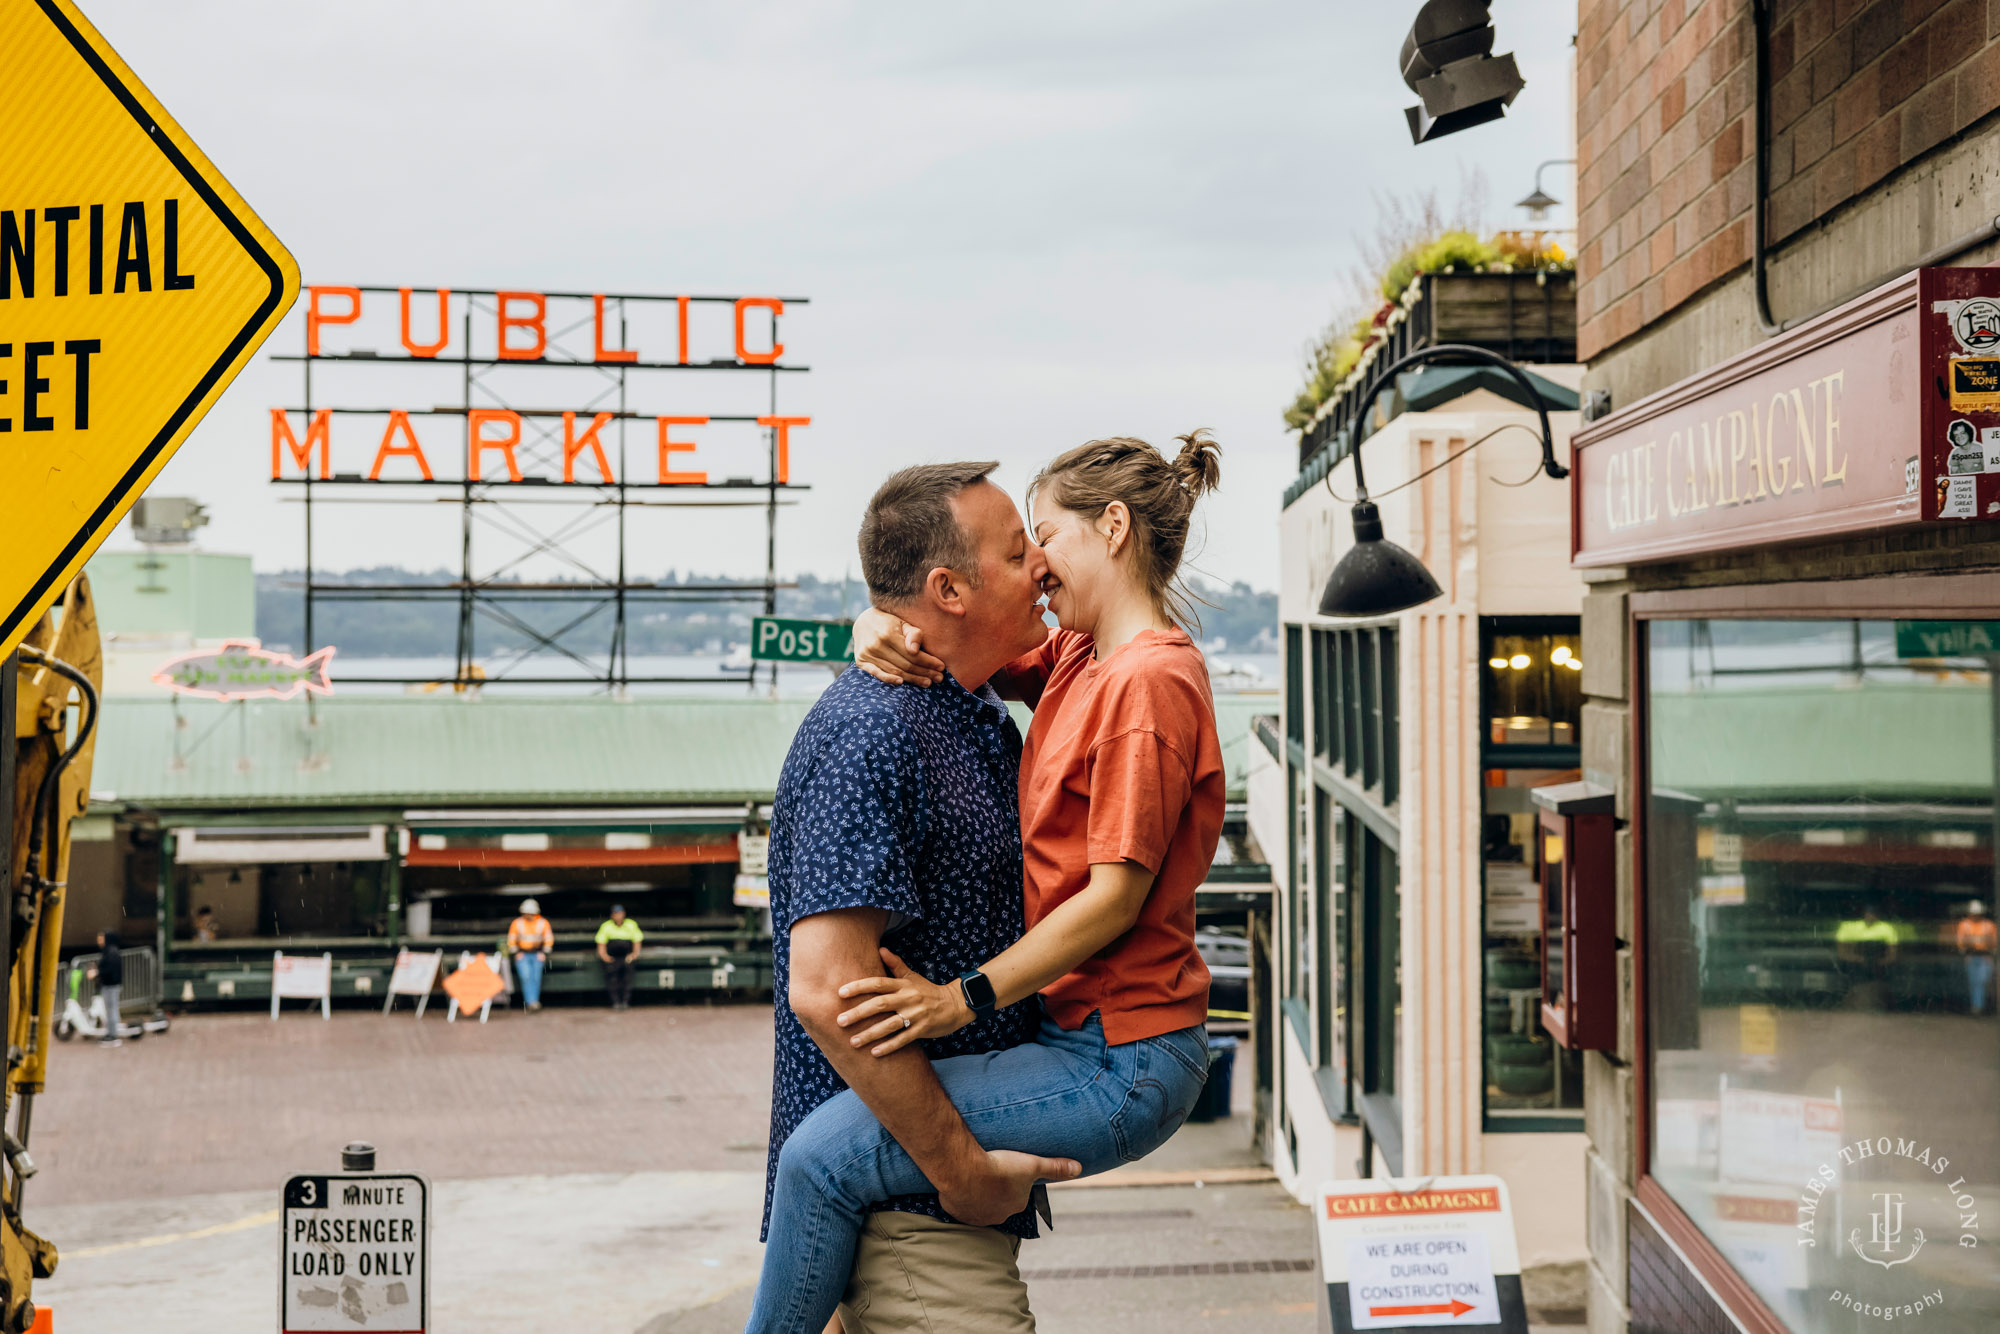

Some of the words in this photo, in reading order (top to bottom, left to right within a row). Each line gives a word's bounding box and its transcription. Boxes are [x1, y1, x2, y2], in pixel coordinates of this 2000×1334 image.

[1, 199, 195, 299] NTIAL
[307, 285, 785, 365] PUBLIC
[1971, 376, 1998, 385] ZONE
[271, 408, 811, 485] MARKET
[1666, 368, 1848, 519] CAMPAGNE
[759, 621, 828, 657] Post
[301, 1180, 317, 1205] 3
[1385, 1191, 1493, 1211] CAMPAGNE
[295, 1219, 414, 1243] PASSENGER
[1366, 1244, 1390, 1257] WE
[1393, 1242, 1422, 1255] ARE
[1425, 1240, 1467, 1255] OPEN
[293, 1252, 345, 1276] LOAD
[359, 1252, 415, 1276] ONLY
[1390, 1262, 1449, 1278] DURING
